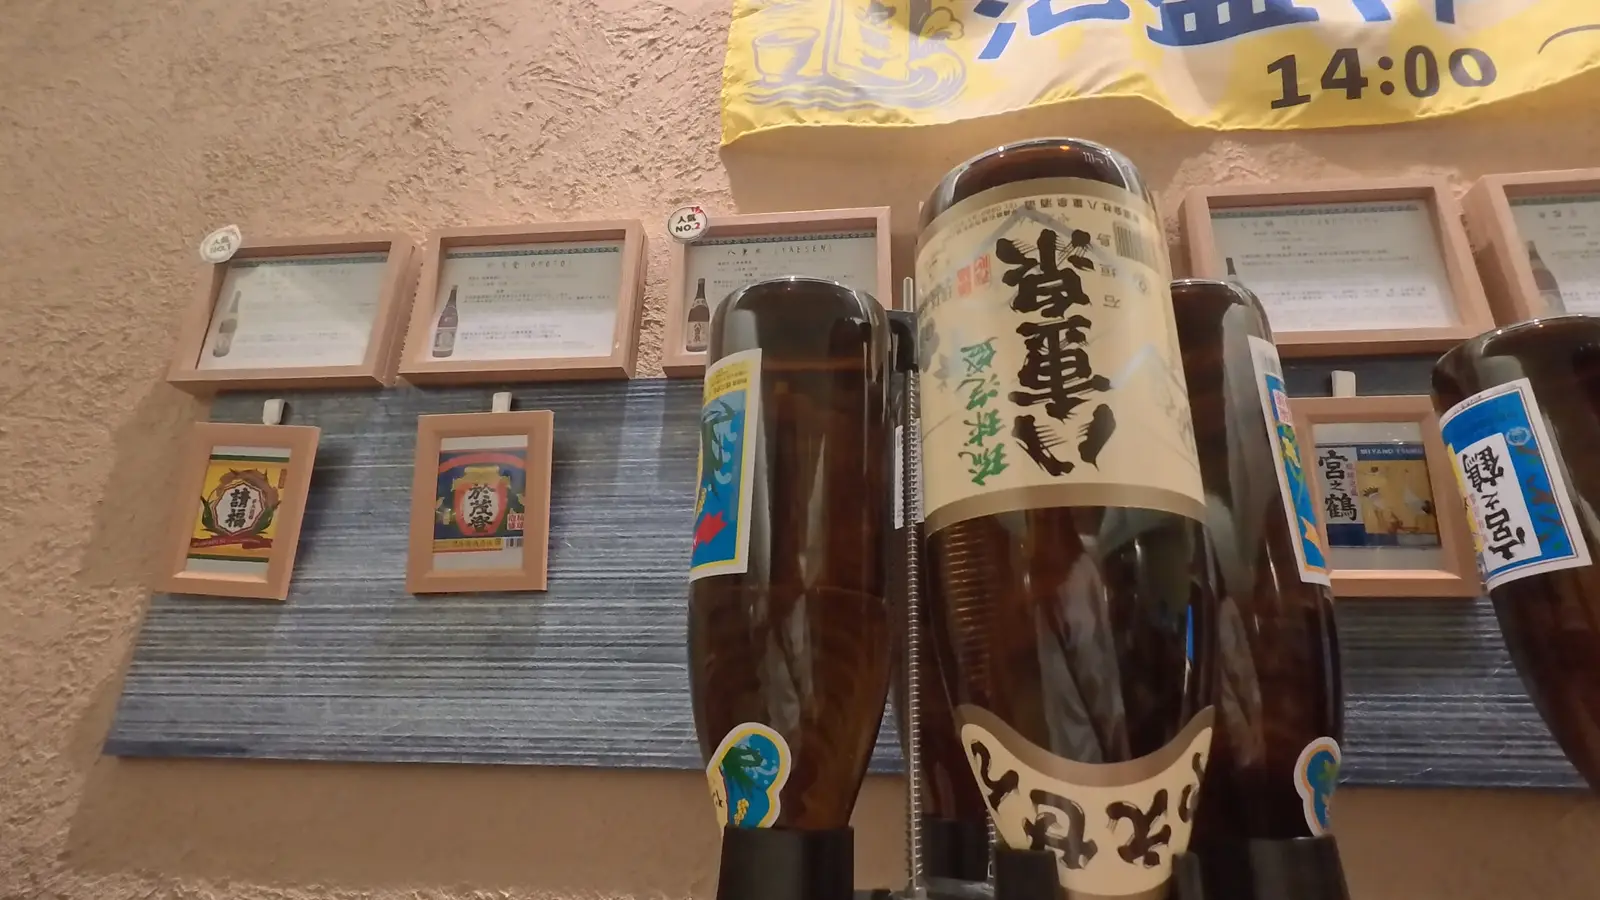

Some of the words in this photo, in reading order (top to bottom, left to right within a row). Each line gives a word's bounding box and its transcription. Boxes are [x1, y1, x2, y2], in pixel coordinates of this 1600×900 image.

[1266, 43, 1498, 109] 14:00
[675, 222, 701, 232] NO.2
[995, 228, 1117, 477] 八重泉
[955, 336, 1010, 486] 琉球泡盛
[224, 487, 251, 528] 請福
[1319, 450, 1357, 522] 宮之鶴
[1462, 445, 1526, 561] 宮之鶴
